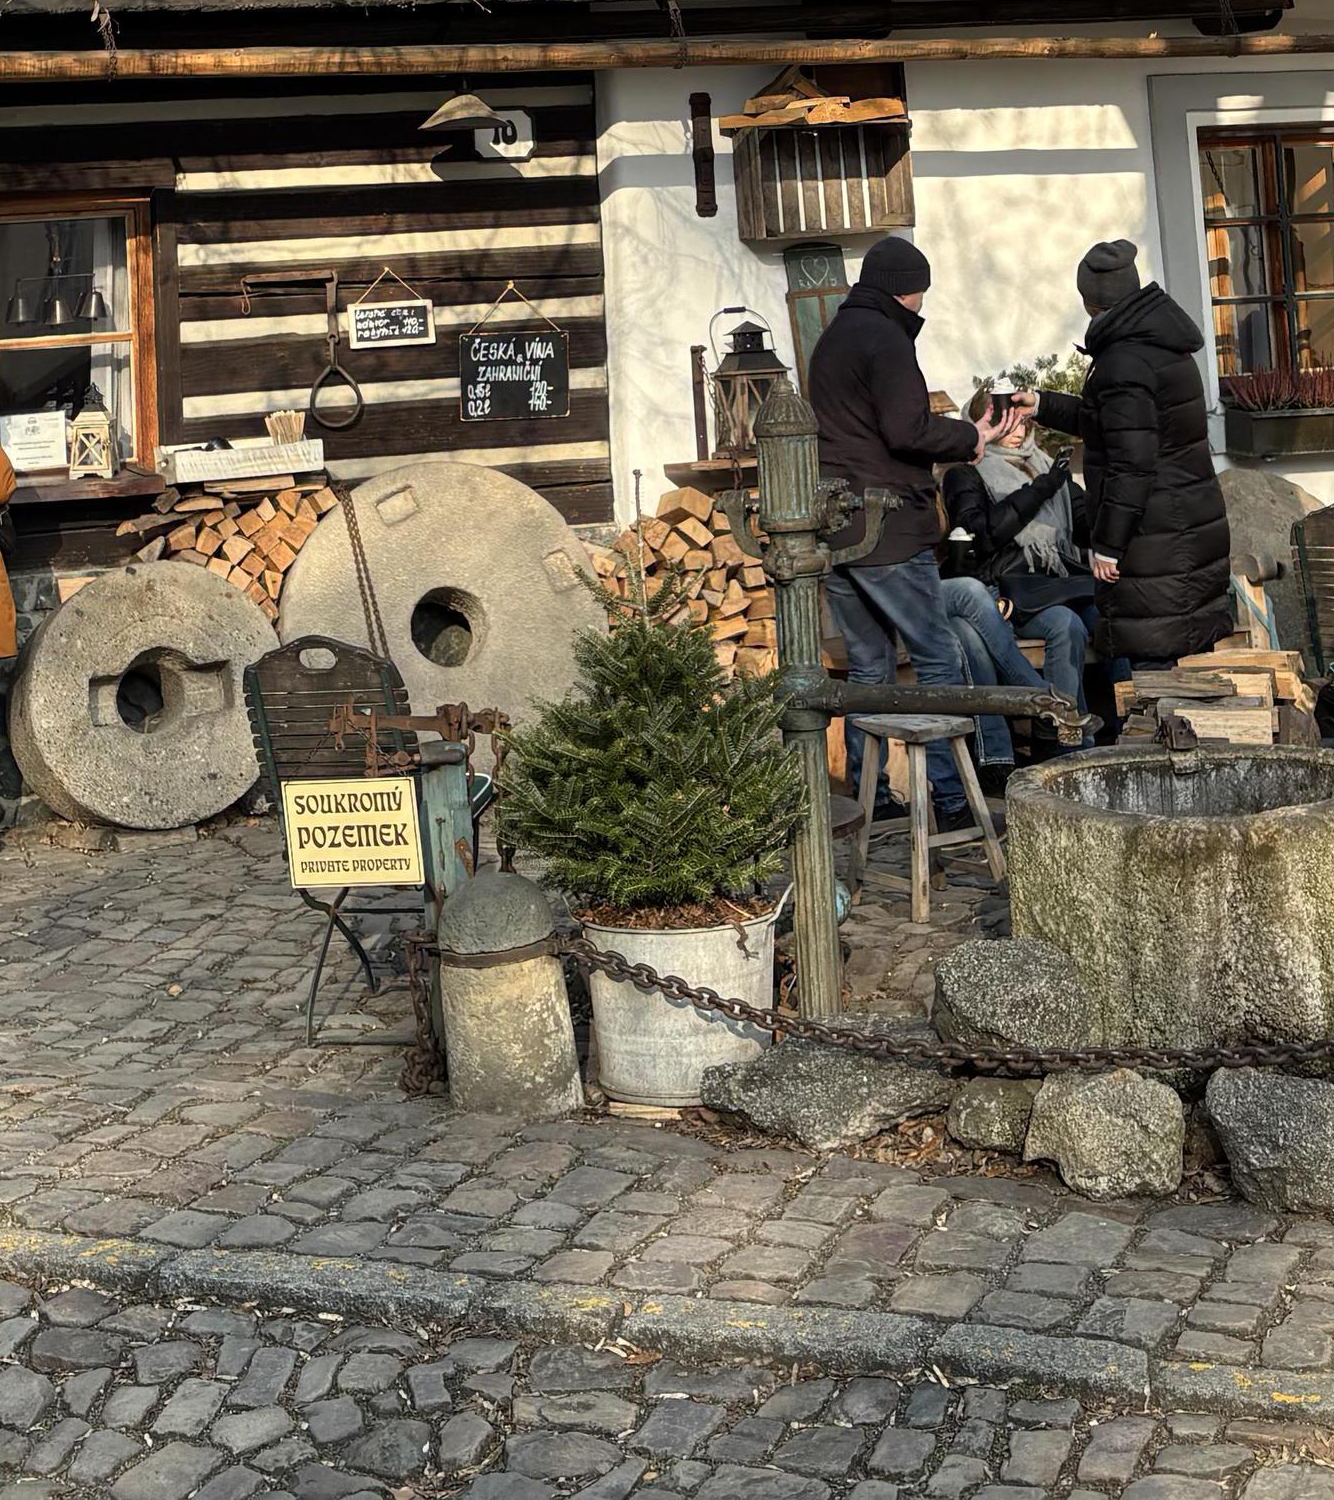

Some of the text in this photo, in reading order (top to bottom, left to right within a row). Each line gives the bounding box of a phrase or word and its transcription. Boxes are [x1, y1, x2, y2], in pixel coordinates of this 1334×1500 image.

[470, 337, 516, 361] ČESKÁ
[525, 337, 555, 359] VÍNA
[476, 360, 543, 382] ZAHRANIČNÍ
[294, 786, 403, 816] SOUKROMÝ
[297, 823, 410, 850] POZEMEK
[300, 858, 411, 874] PRIVATE PROPERTY
